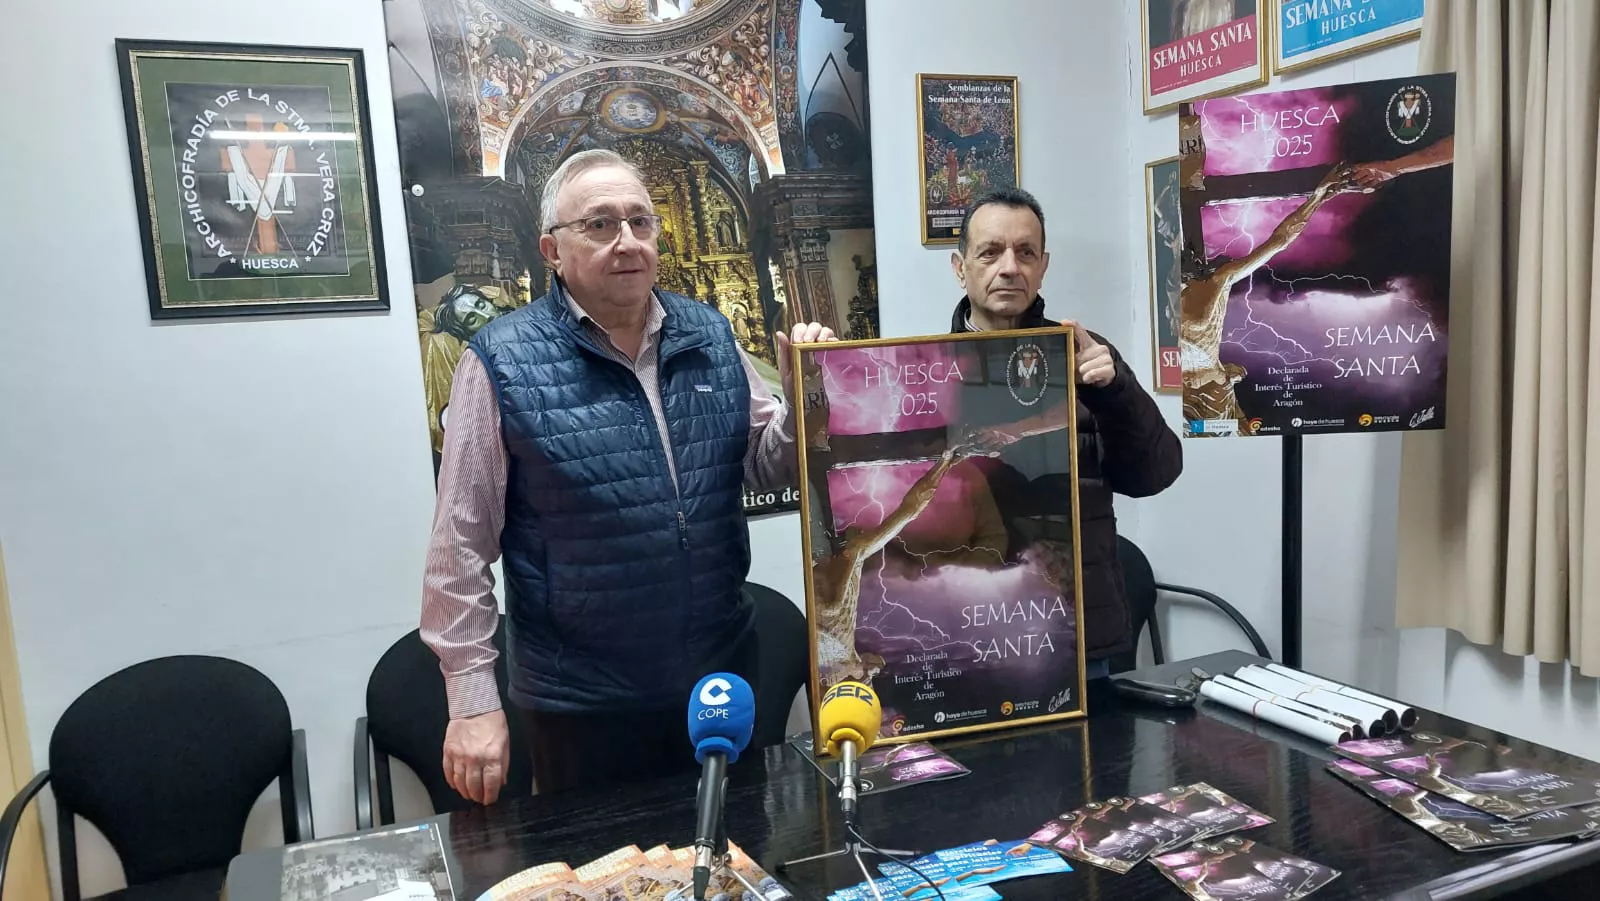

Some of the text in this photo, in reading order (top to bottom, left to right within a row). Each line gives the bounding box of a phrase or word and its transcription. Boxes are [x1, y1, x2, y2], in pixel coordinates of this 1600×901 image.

[1321, 7, 1376, 36] HUESCA
[1153, 40, 1205, 70] SEMANA
[1210, 21, 1253, 52] SANTA
[1180, 54, 1222, 77] HUESCA
[247, 87, 271, 106] LA
[948, 83, 1011, 93] Semblanzas de la
[215, 89, 240, 109] DE
[928, 94, 1011, 104] Semana Santa de León
[1240, 104, 1340, 134] HUESCA
[1264, 134, 1313, 158] 2025
[181, 108, 233, 259] ARCHICOFRADÍA
[315, 152, 335, 202] VERA
[306, 207, 335, 257] CRUZ
[241, 257, 300, 270] HUESCA
[1324, 321, 1436, 349] SEMANA
[865, 360, 964, 389] HUESCA
[1268, 366, 1309, 375] Declarada
[1333, 355, 1421, 379] SANTA
[1255, 383, 1283, 391] Interés
[1282, 374, 1294, 382] de
[1273, 398, 1303, 407] Aragón
[1282, 390, 1293, 398] de
[892, 392, 938, 417] 2025
[961, 596, 1067, 630] SEMANA
[906, 650, 948, 663] Declarada
[972, 631, 1055, 663] SANTA
[922, 661, 933, 671] de
[894, 672, 924, 685] Interés
[923, 681, 934, 690] de
[822, 684, 873, 710] SER
[914, 690, 945, 701] Aragón
[697, 708, 729, 721] COPE
